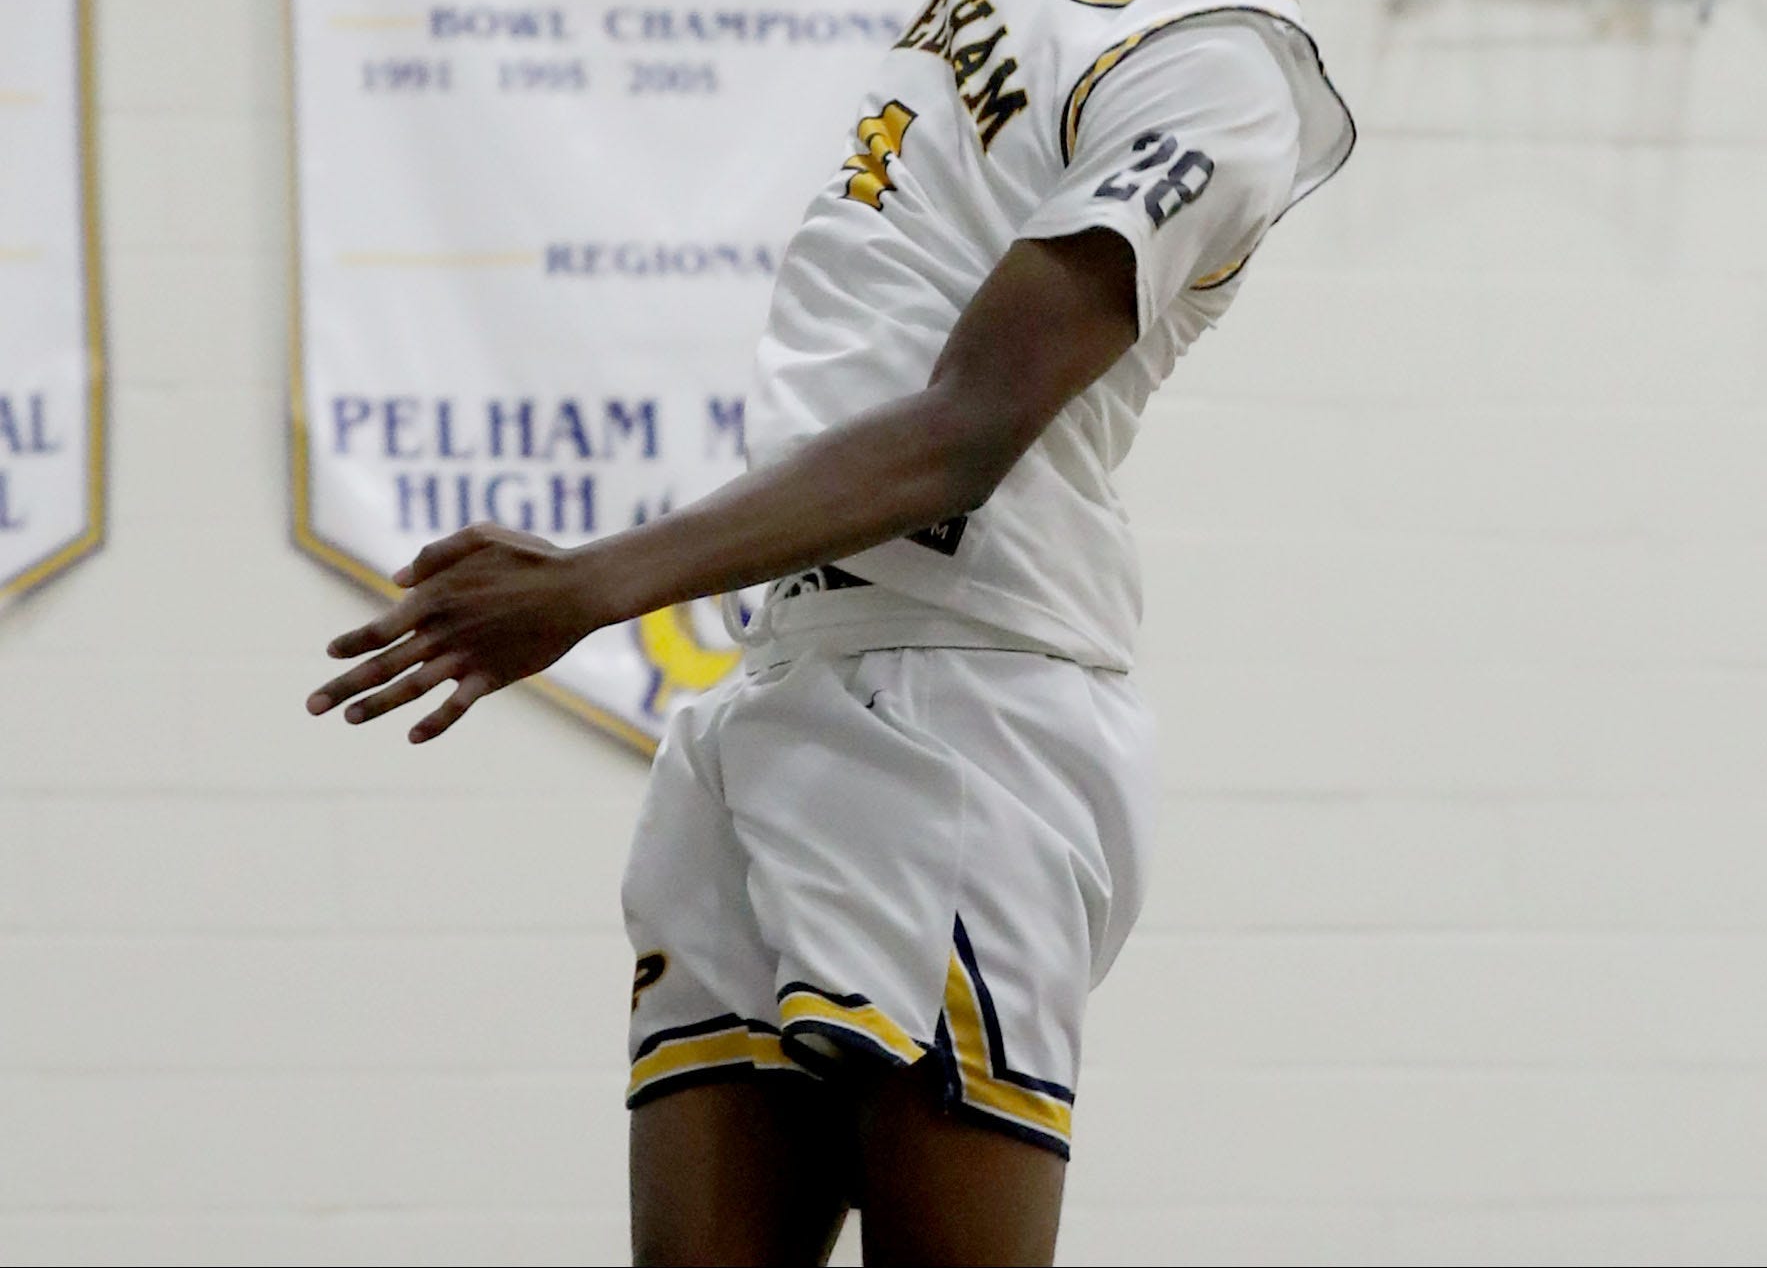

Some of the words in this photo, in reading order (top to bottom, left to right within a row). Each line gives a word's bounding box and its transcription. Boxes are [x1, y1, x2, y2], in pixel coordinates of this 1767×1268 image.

[428, 6, 568, 42] BOWL
[1094, 132, 1215, 229] 28
[545, 242, 780, 279] REGIONA
[328, 394, 660, 461] PELHAM
[395, 470, 597, 535] HIGH
